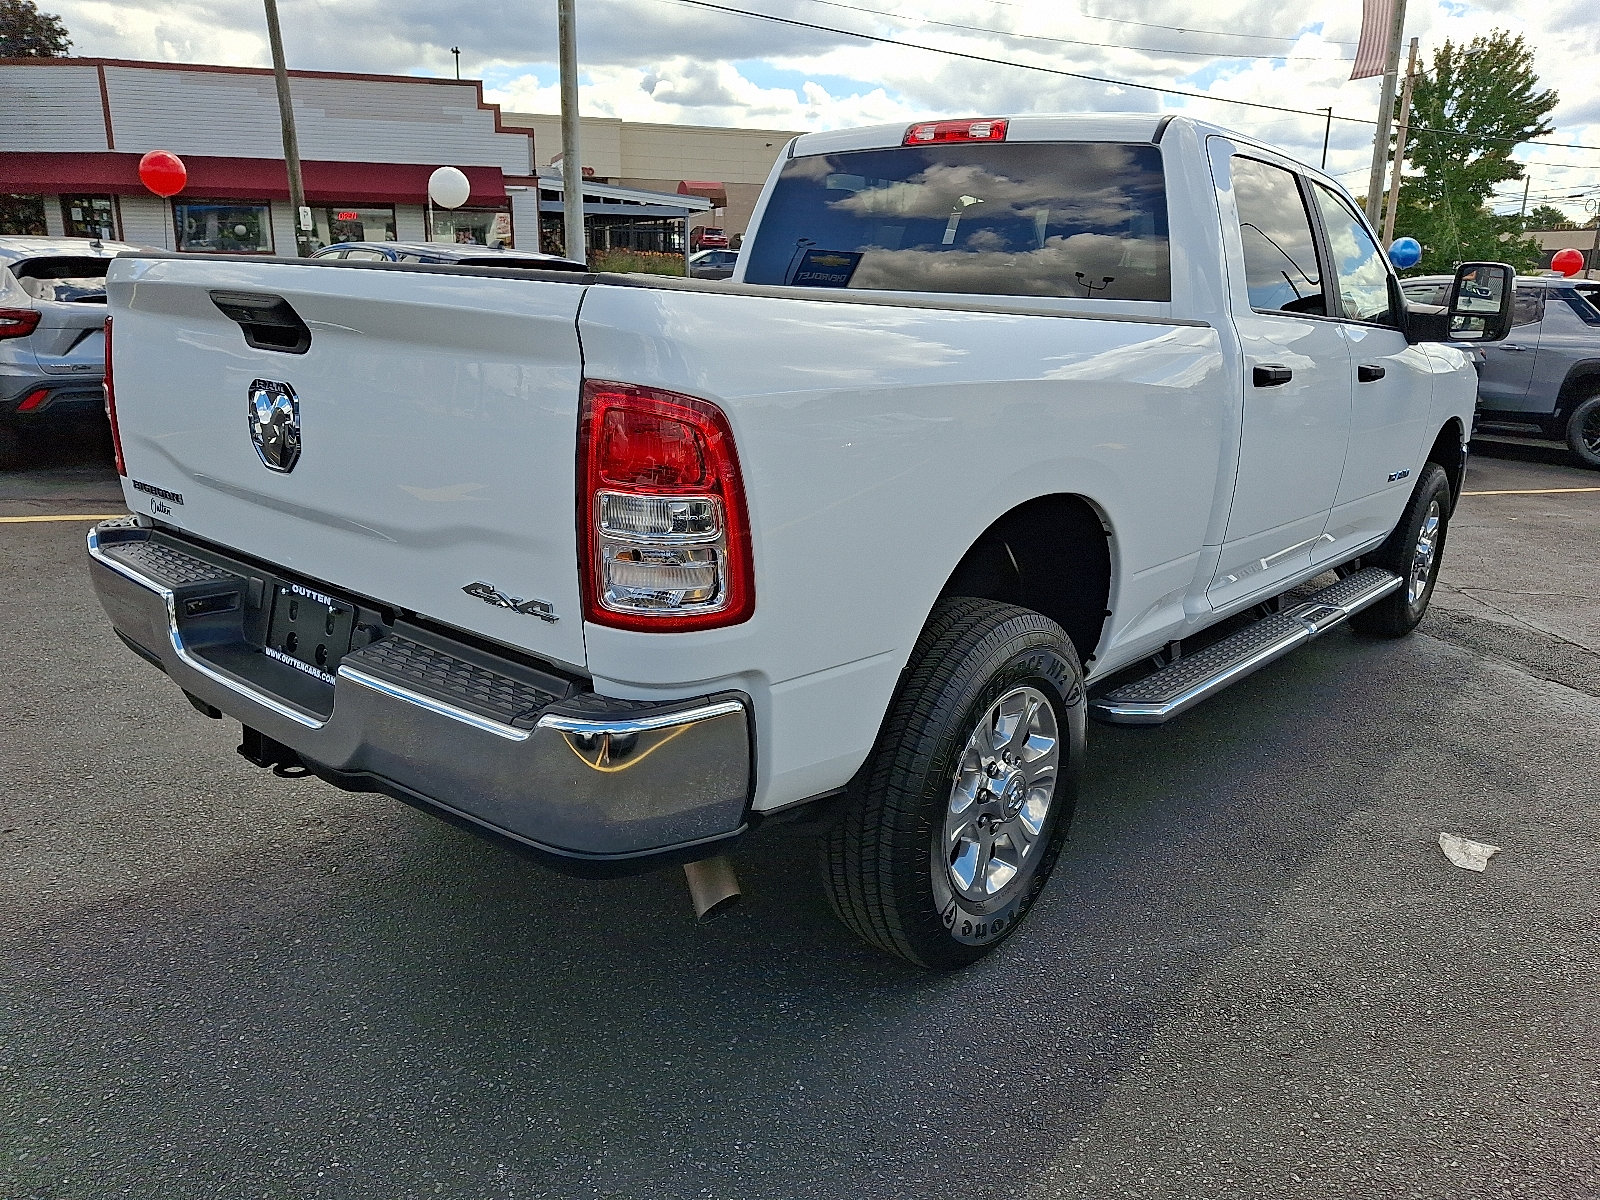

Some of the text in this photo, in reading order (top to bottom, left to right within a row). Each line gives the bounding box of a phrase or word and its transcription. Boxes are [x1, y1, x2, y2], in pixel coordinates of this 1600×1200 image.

[338, 212, 358, 220] OPEN
[255, 379, 286, 393] RAM
[292, 584, 334, 605] OUTTEN
[265, 647, 336, 686] WWW.OUTTENCARS.COM
